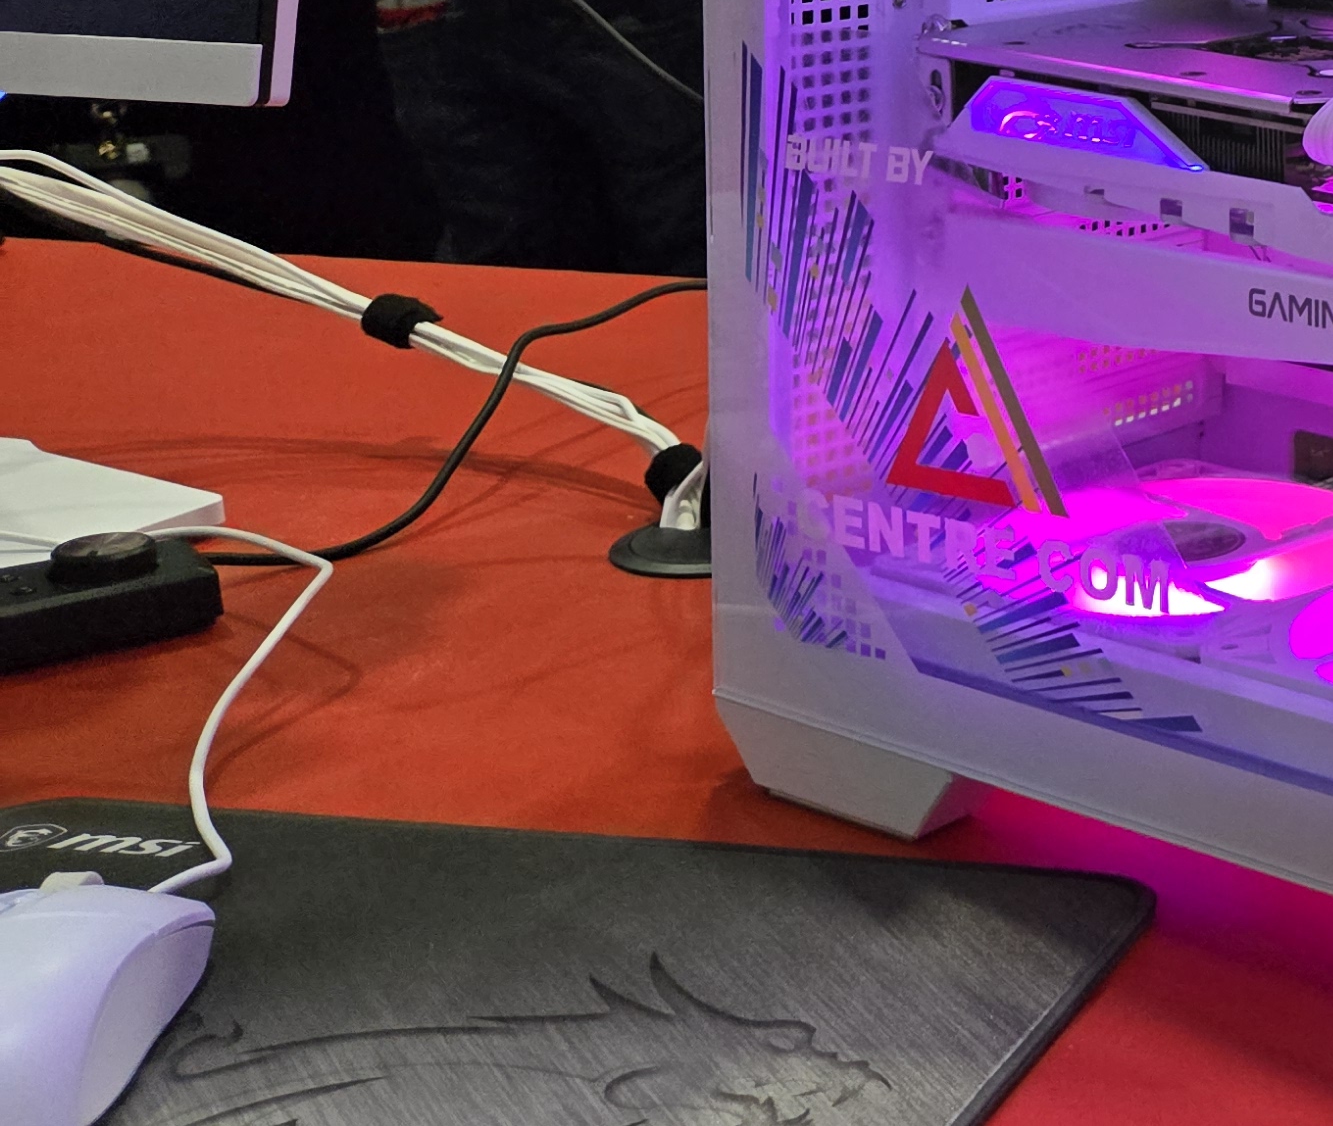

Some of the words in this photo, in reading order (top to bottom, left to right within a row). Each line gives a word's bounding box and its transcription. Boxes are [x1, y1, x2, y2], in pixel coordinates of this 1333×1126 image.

[784, 134, 878, 179] BUILT
[886, 145, 935, 185] BY
[800, 488, 1017, 580] CENTRE
[1037, 539, 1171, 614] COM
[47, 832, 202, 858] msi
